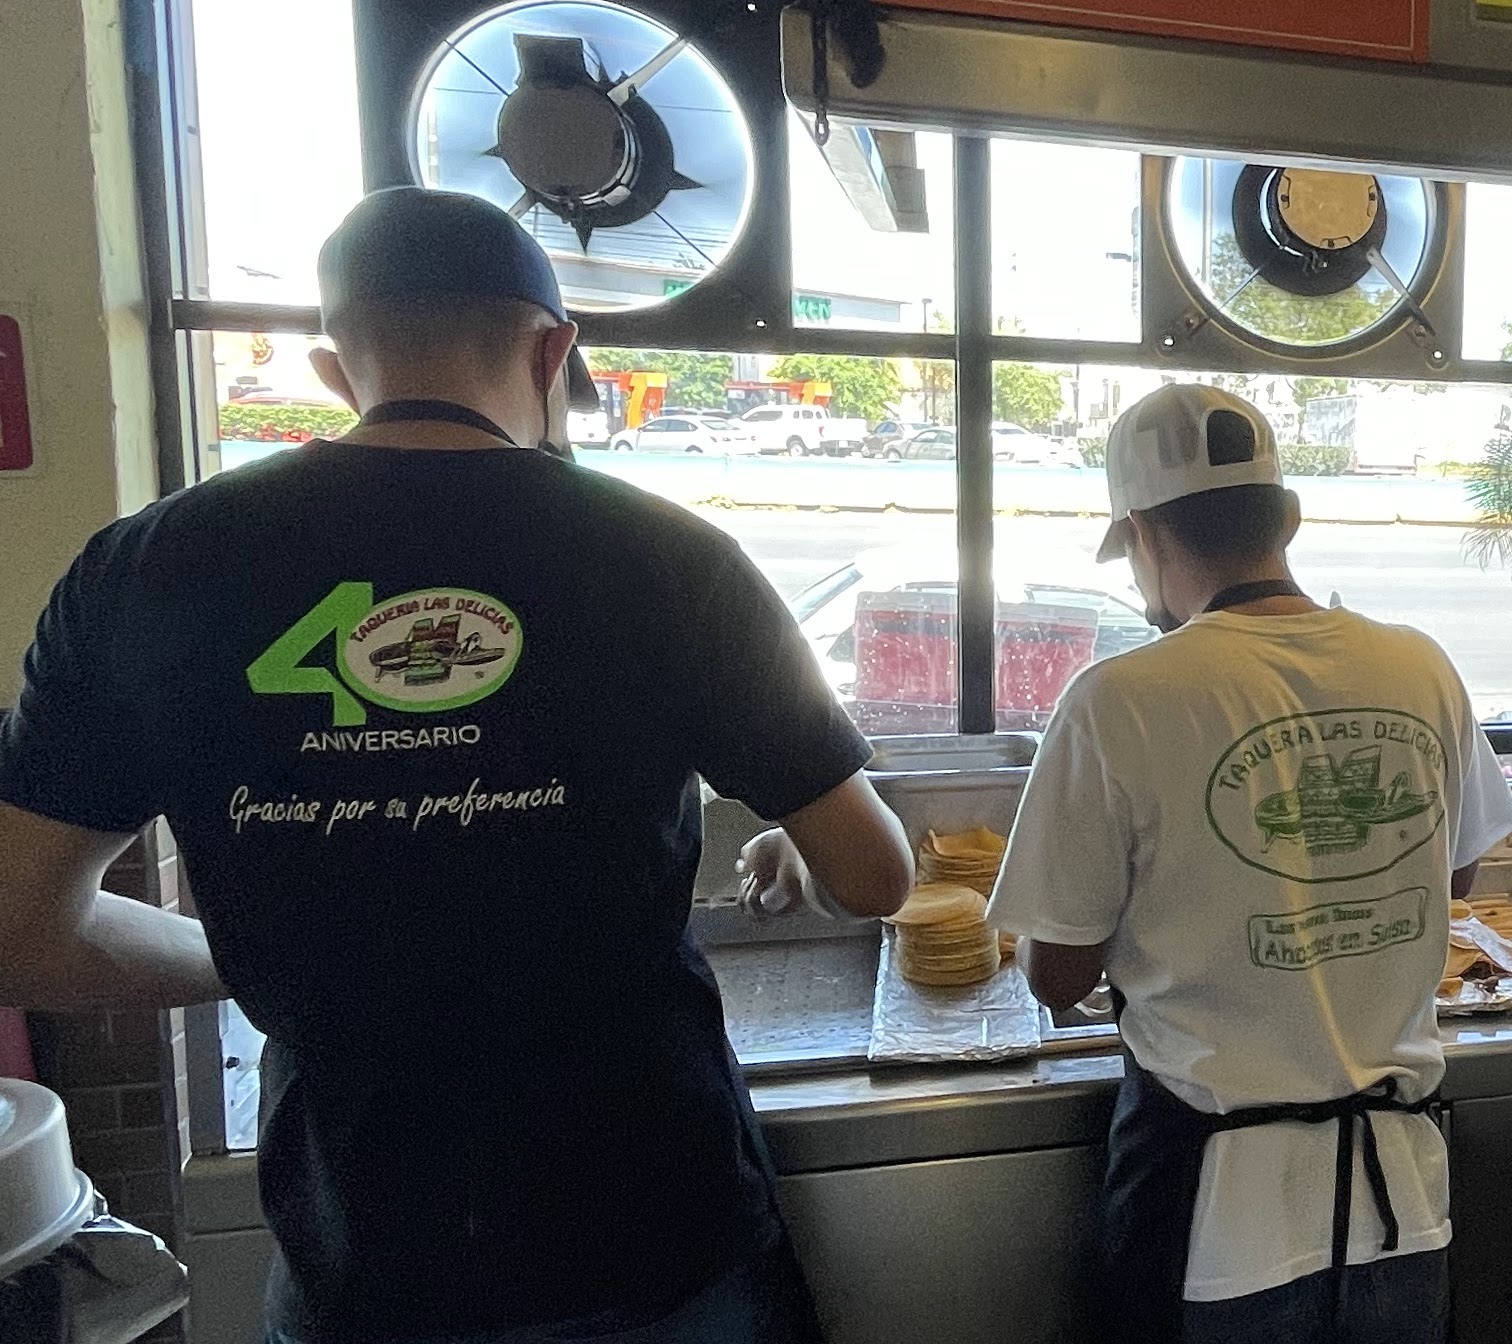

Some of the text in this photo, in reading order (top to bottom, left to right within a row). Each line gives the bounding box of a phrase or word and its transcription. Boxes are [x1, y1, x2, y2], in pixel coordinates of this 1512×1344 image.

[349, 596, 515, 644] TAQUERIA LAS DELICIAS
[300, 724, 481, 753] ANIVERSARIO
[1318, 720, 1362, 741] LAS
[229, 777, 566, 836] Gracias por su preferencia
